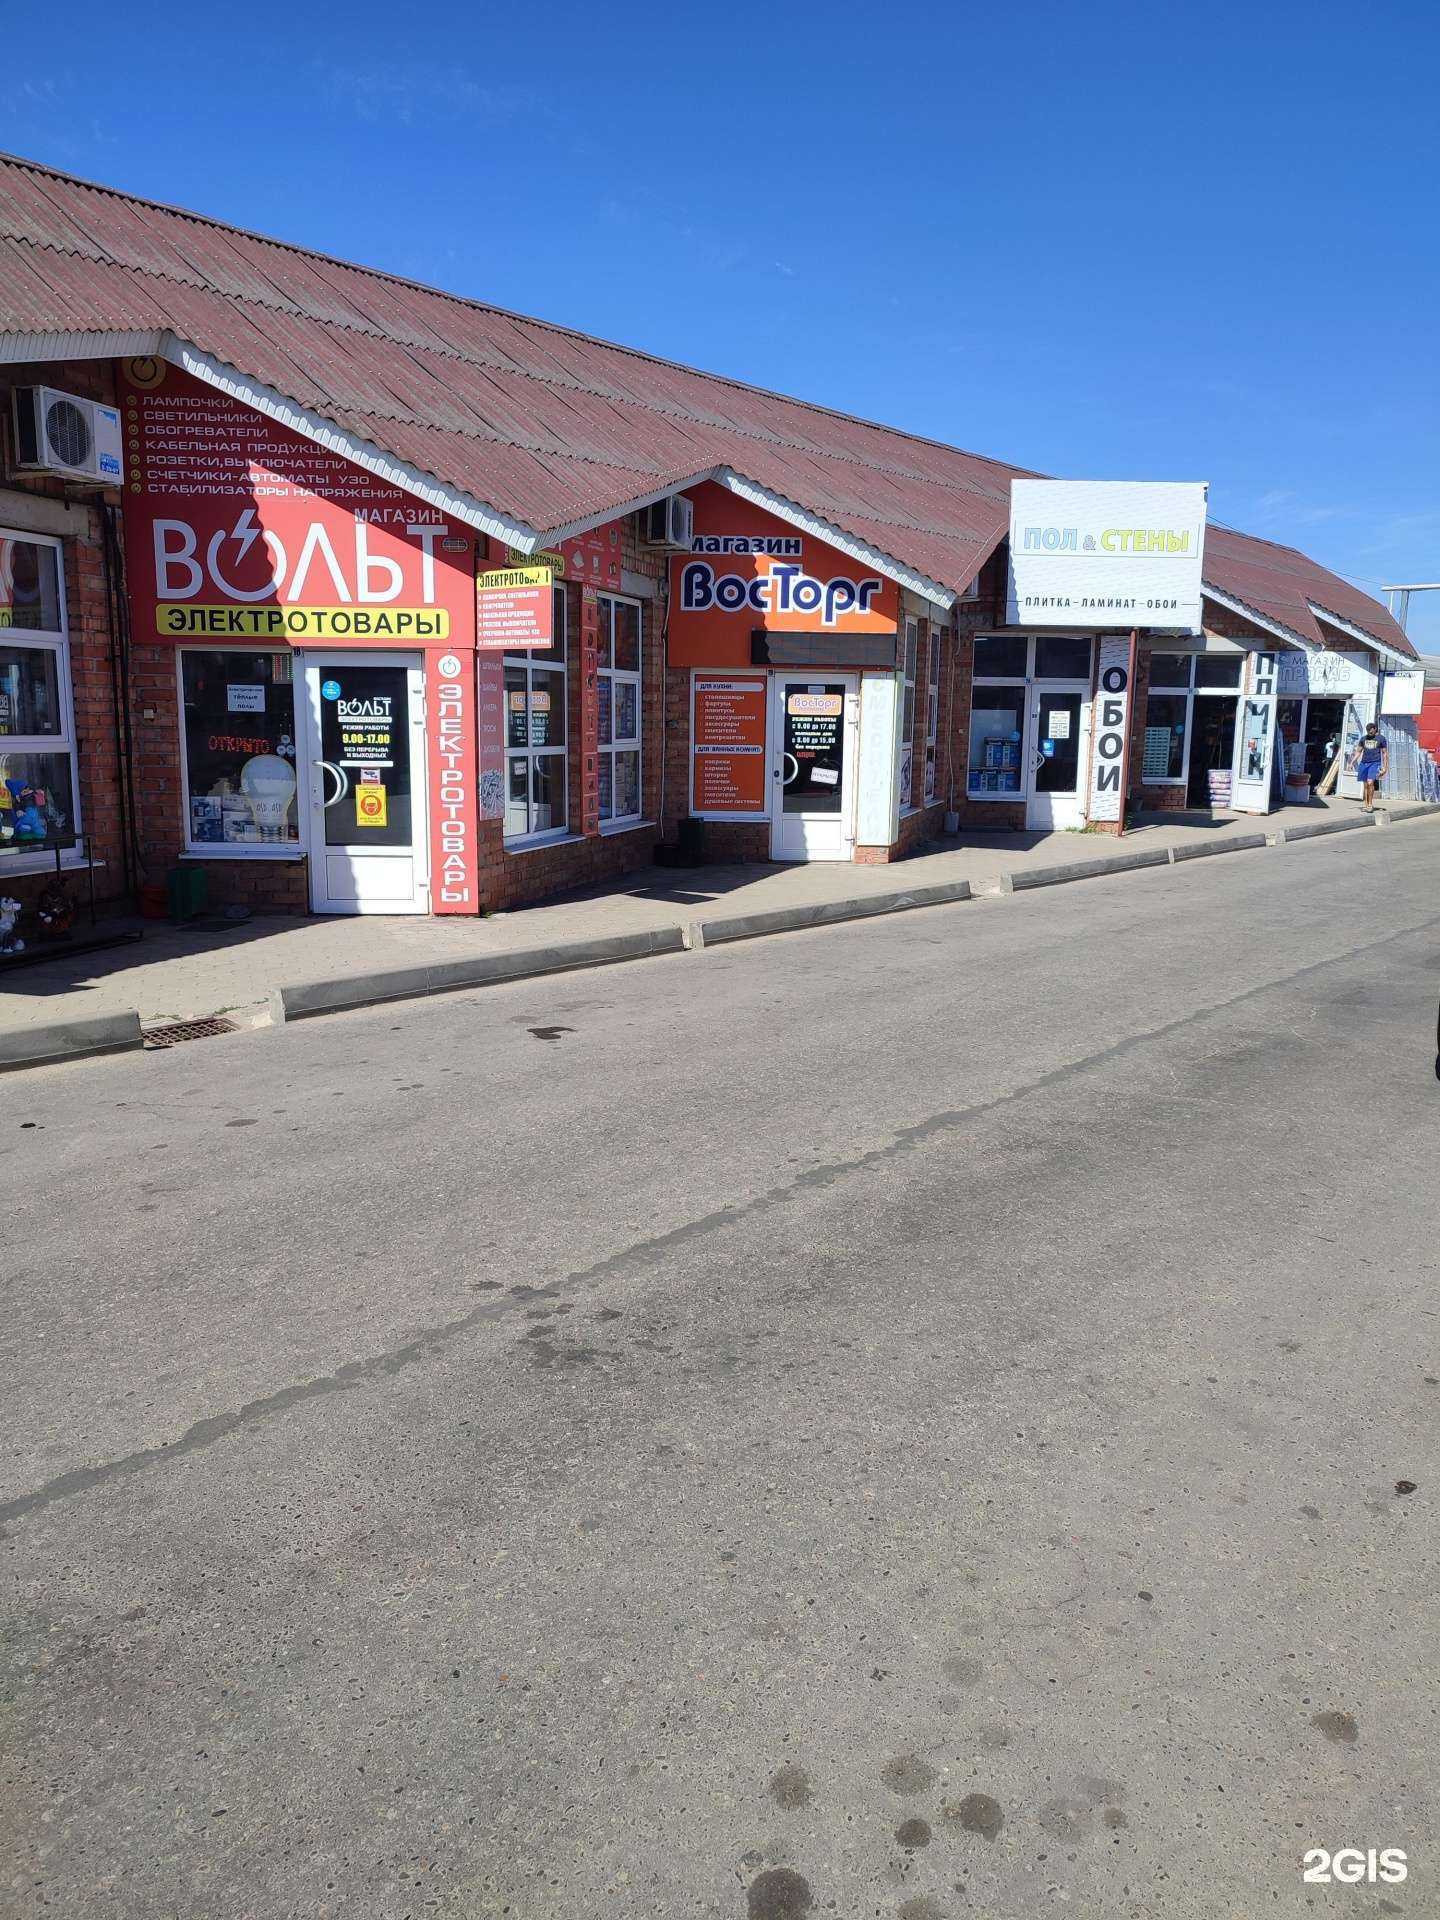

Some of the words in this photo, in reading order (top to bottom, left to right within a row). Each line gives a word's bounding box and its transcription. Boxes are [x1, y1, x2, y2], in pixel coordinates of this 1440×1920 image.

[142, 397, 234, 408] ЛАМПОЧКИ
[143, 411, 262, 423] СВЕТИЛЬНИКИ
[144, 426, 269, 437] ОБОГРЕВАТЕЛИ
[145, 441, 241, 452] КАБЕЛЬНАЯ
[339, 476, 370, 485] УЗО
[148, 484, 289, 496] СТАБИЛИЗАТОРЫ
[293, 488, 403, 499] НАПРЯЖЕНИЯ
[354, 508, 444, 524] МАГАЗИН
[1023, 527, 1078, 550] ПОЛ
[1083, 534, 1097, 551] &
[1100, 528, 1190, 553] СТЕНЫ
[152, 509, 449, 604] ВОЛЬТ
[683, 563, 880, 624] ВосТорг
[1025, 596, 1071, 608] ПЛИТКА
[1081, 597, 1137, 609] ЛАМИНАТ
[1147, 598, 1178, 609] ОБОИ
[167, 608, 442, 635] ЭЛЕКТРОТОВАРЫ
[1291, 656, 1345, 666] МАГАЗИН
[337, 697, 392, 716] ВОЛЬТ
[794, 697, 837, 708] ВосТорг
[1097, 666, 1128, 792] ОБОИ
[208, 736, 272, 753] ОТКРЫТО
[342, 733, 391, 744] 9.00-17.00
[437, 683, 470, 902] ЭЛЕКТРОТОВАРЫ
